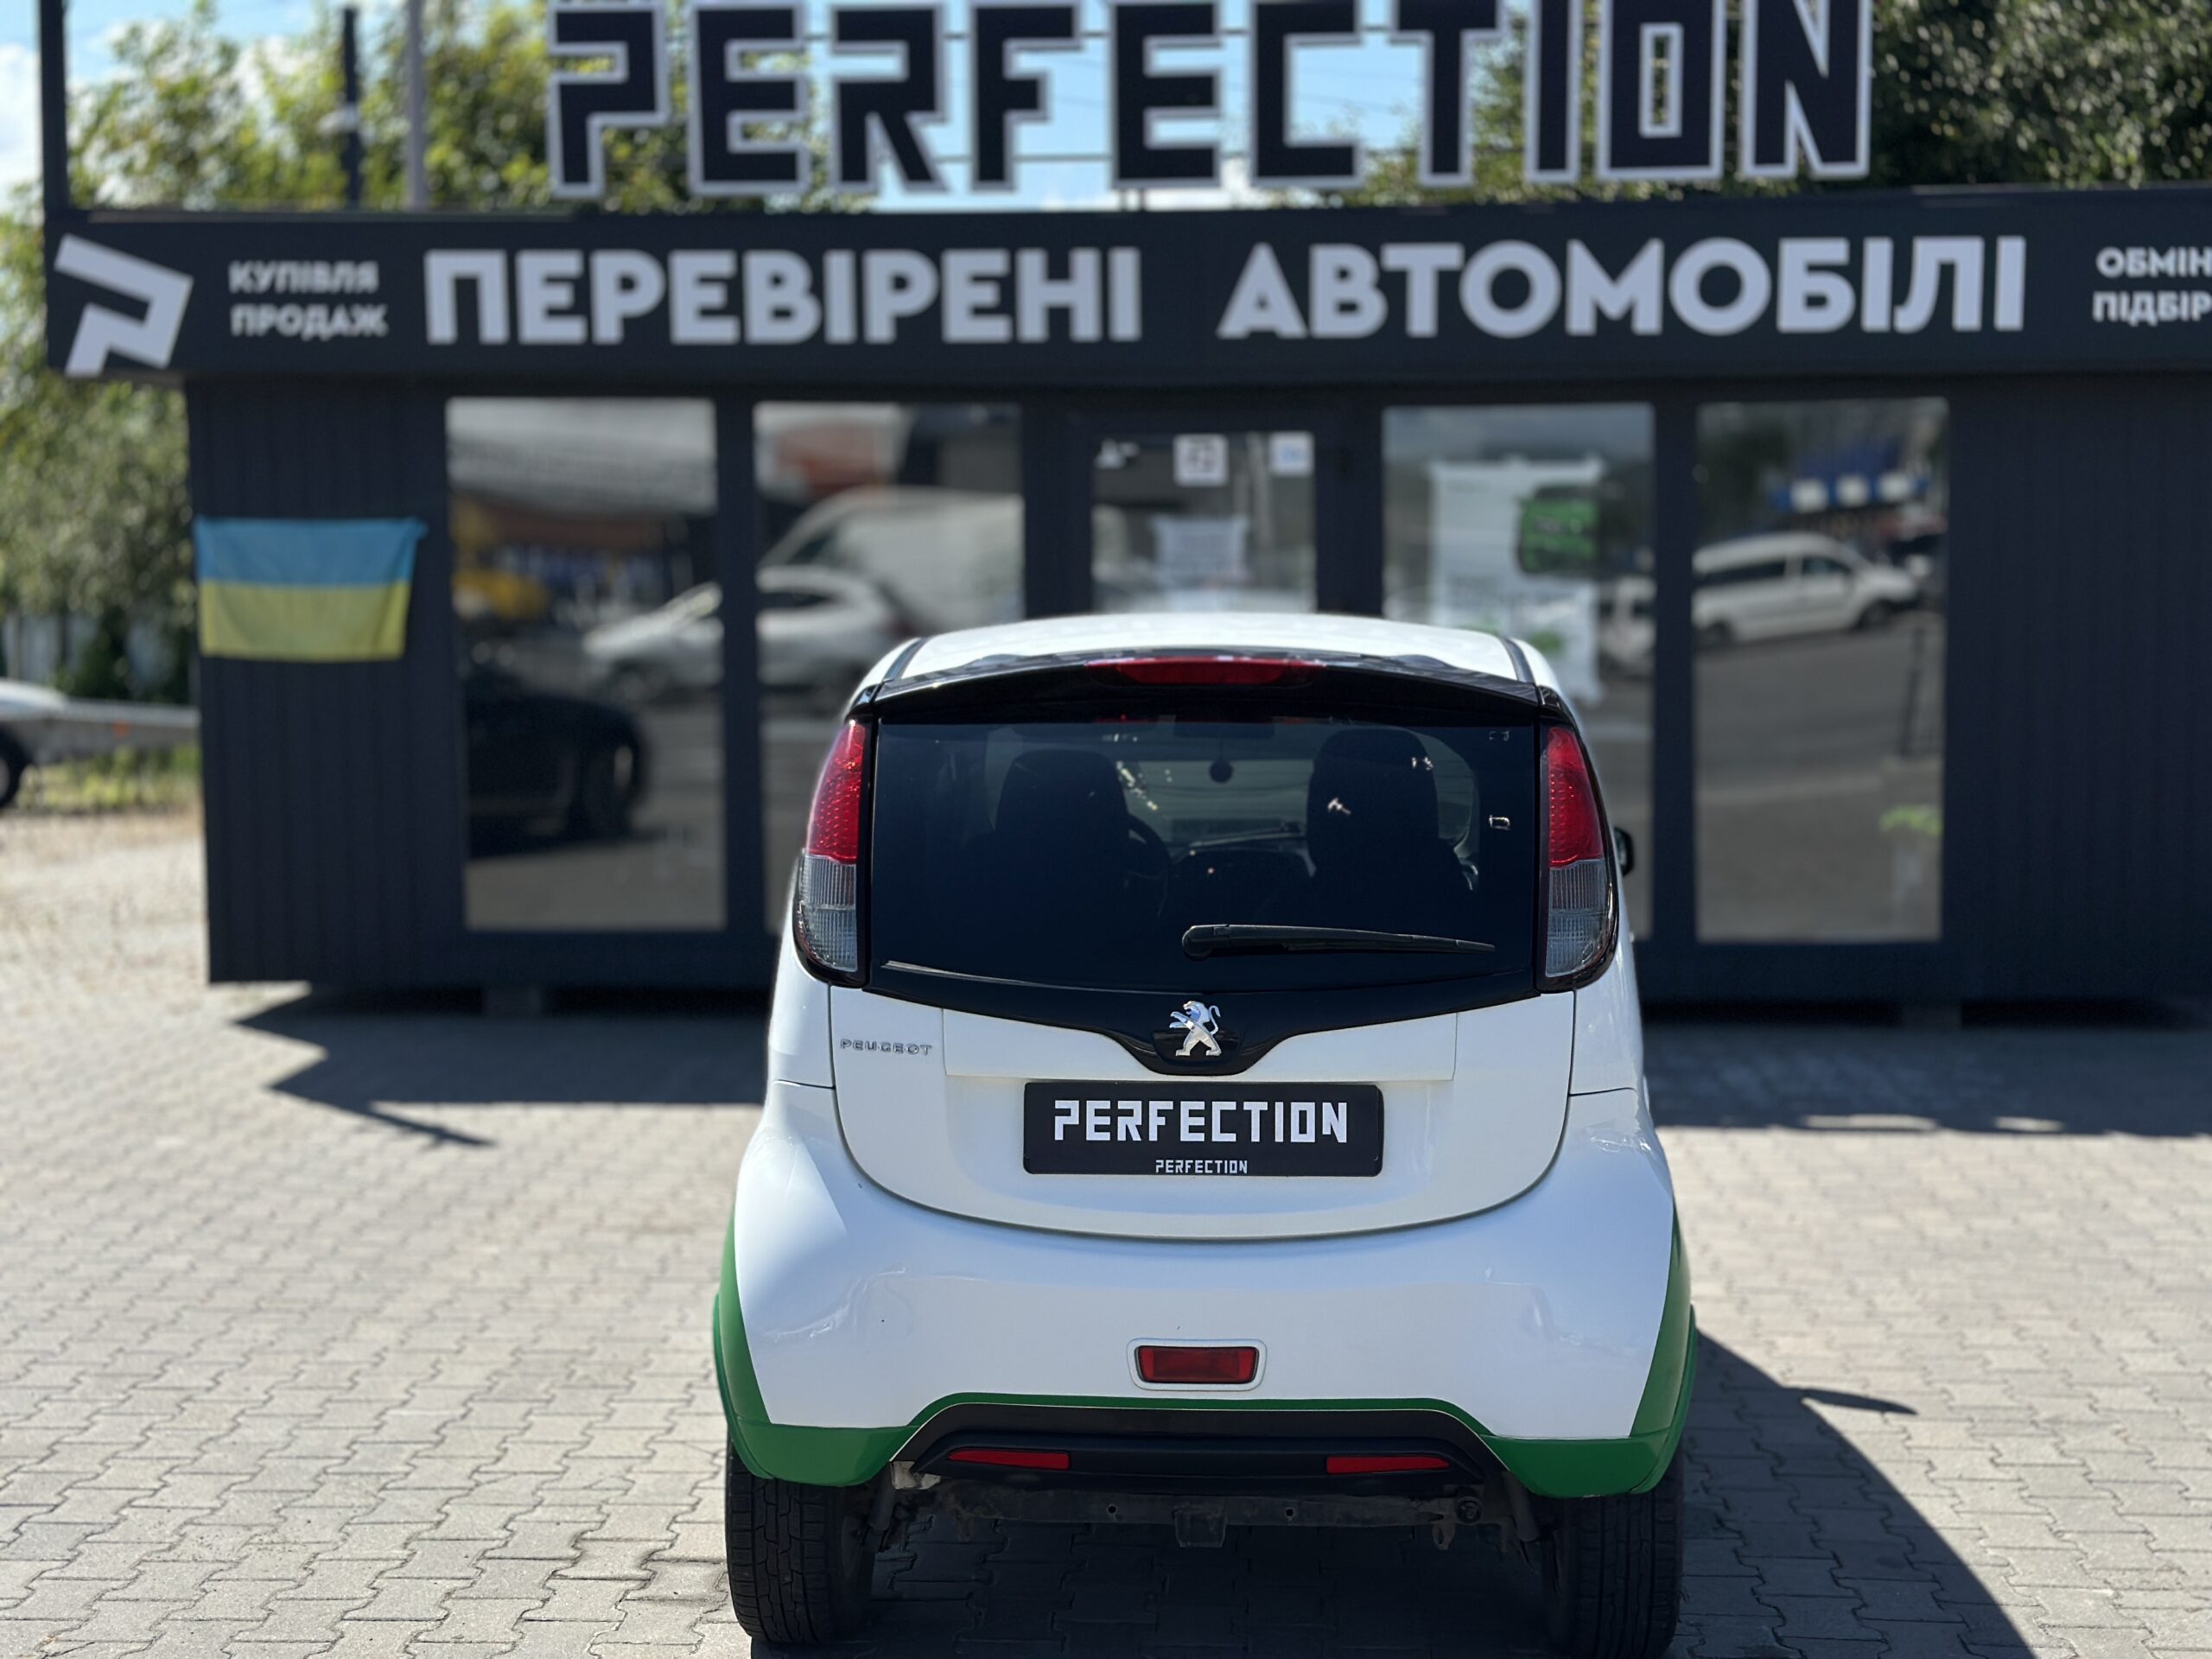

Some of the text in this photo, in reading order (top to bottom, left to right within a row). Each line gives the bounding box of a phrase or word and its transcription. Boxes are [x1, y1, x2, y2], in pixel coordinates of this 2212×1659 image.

[546, 0, 1872, 198] PERFECTION
[228, 261, 379, 294] КУПІВЛЯ
[2095, 245, 2212, 278] ОБМІН
[424, 235, 2027, 346] ПЕРЕВІРЕНІ АВТОМОБІЛІ
[2093, 289, 2212, 327] ПІДБІР
[230, 304, 389, 340] ПРОДАЖ
[840, 1038, 932, 1056] PEUGEOT
[1053, 1099, 1348, 1143] PERFECTION
[1154, 1159, 1249, 1174] PERFECTION
